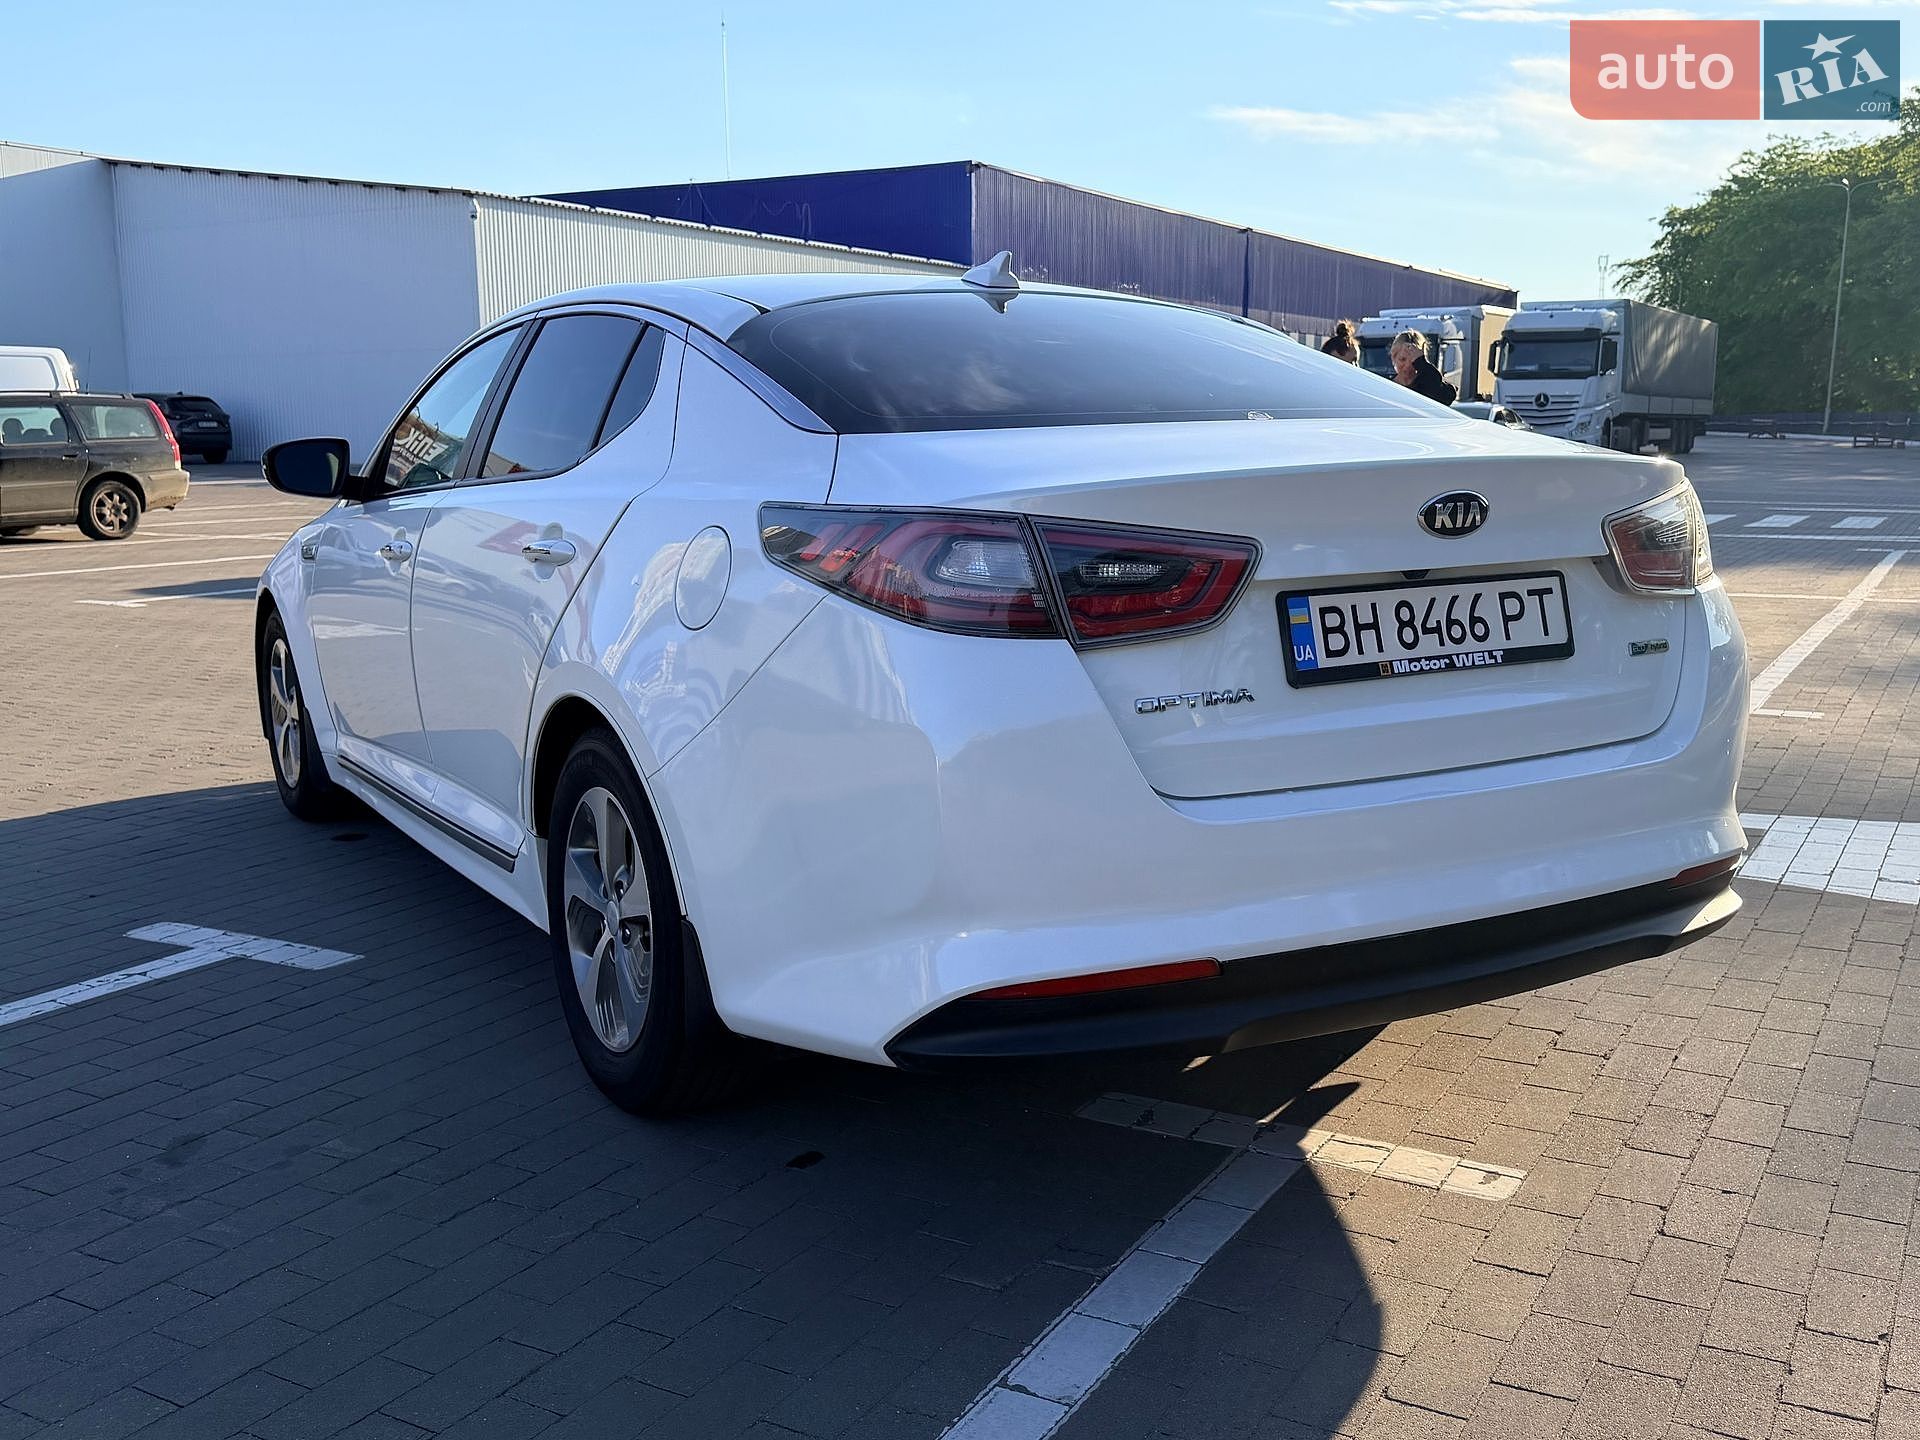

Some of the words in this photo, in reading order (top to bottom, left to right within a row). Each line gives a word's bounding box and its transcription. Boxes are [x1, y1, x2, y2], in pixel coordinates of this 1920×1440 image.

[1434, 501, 1481, 529] KIA
[1318, 602, 1385, 659] BH
[1394, 592, 1490, 651] 8466
[1497, 587, 1554, 641] PT
[1294, 645, 1315, 662] UA
[1392, 658, 1450, 674] Motor
[1451, 650, 1504, 668] WELT
[1134, 688, 1256, 714] OPTIMA
